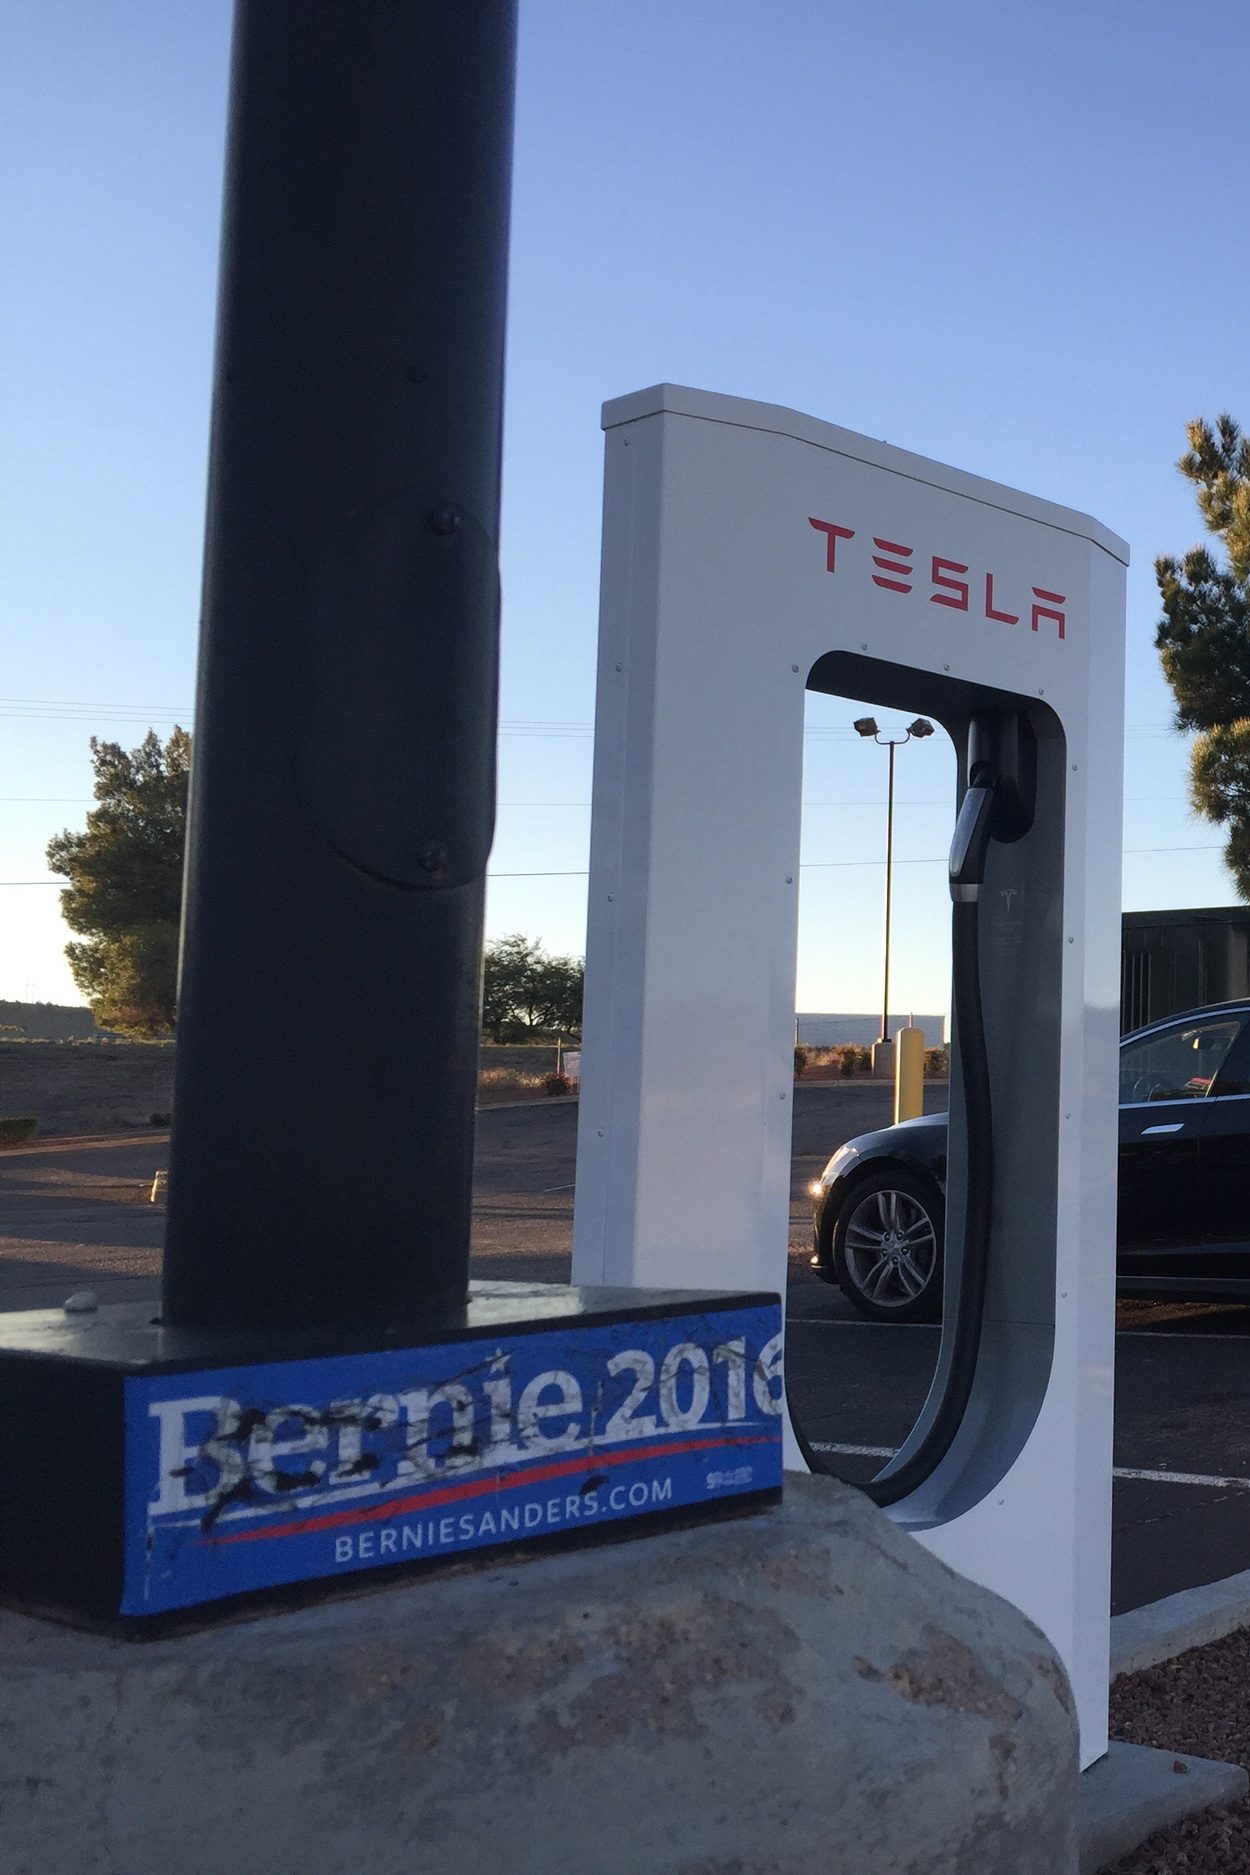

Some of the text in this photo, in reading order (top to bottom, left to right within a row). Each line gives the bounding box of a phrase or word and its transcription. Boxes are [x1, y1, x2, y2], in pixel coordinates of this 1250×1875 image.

[807, 516, 1067, 640] TESLA
[147, 1347, 584, 1517] Bernie
[334, 1476, 673, 1564] BERNIESANDERS.COM
